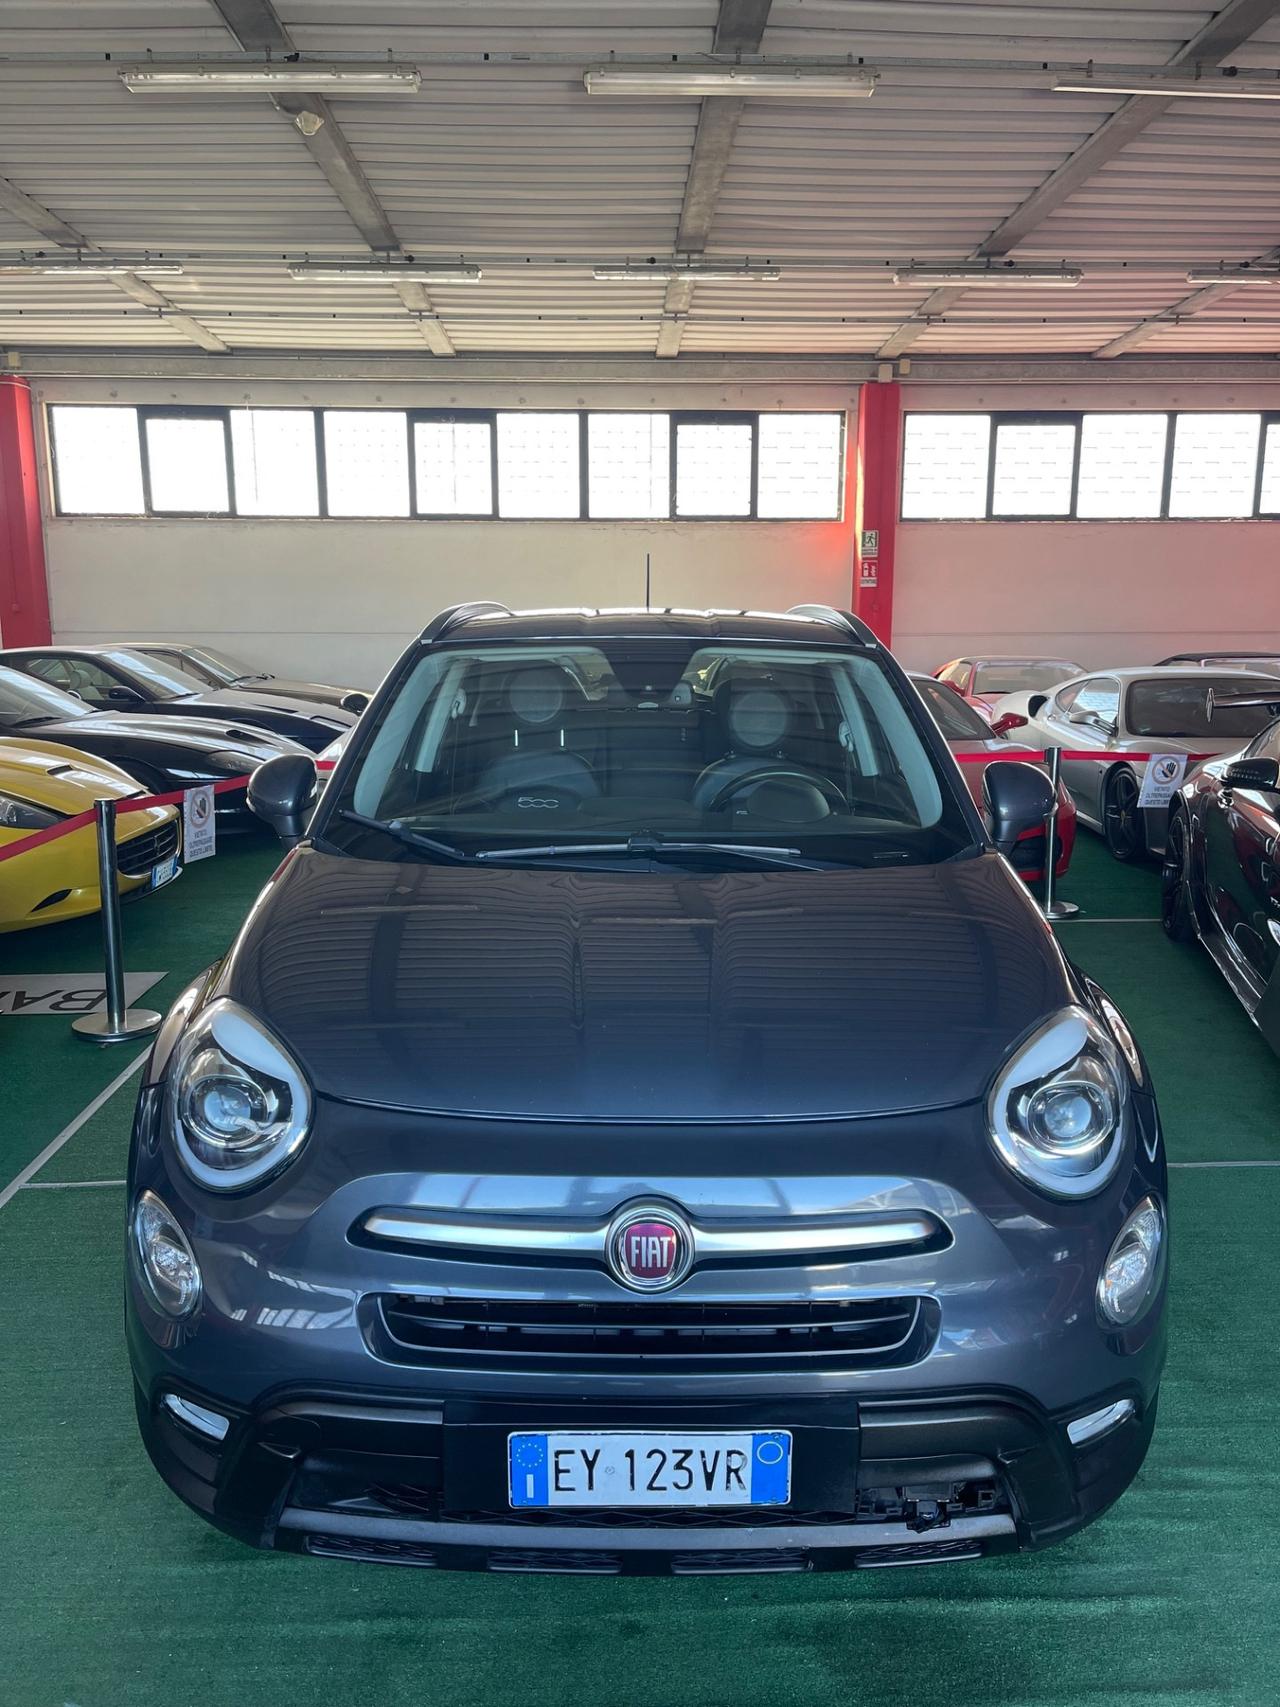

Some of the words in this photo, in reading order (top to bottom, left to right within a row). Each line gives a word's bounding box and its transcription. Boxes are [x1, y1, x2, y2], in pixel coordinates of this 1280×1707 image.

[518, 796, 560, 809] 500
[0, 989, 107, 1012] BA
[631, 1236, 671, 1268] FIAT
[554, 1449, 600, 1492] EY
[624, 1449, 748, 1492] 123VR
